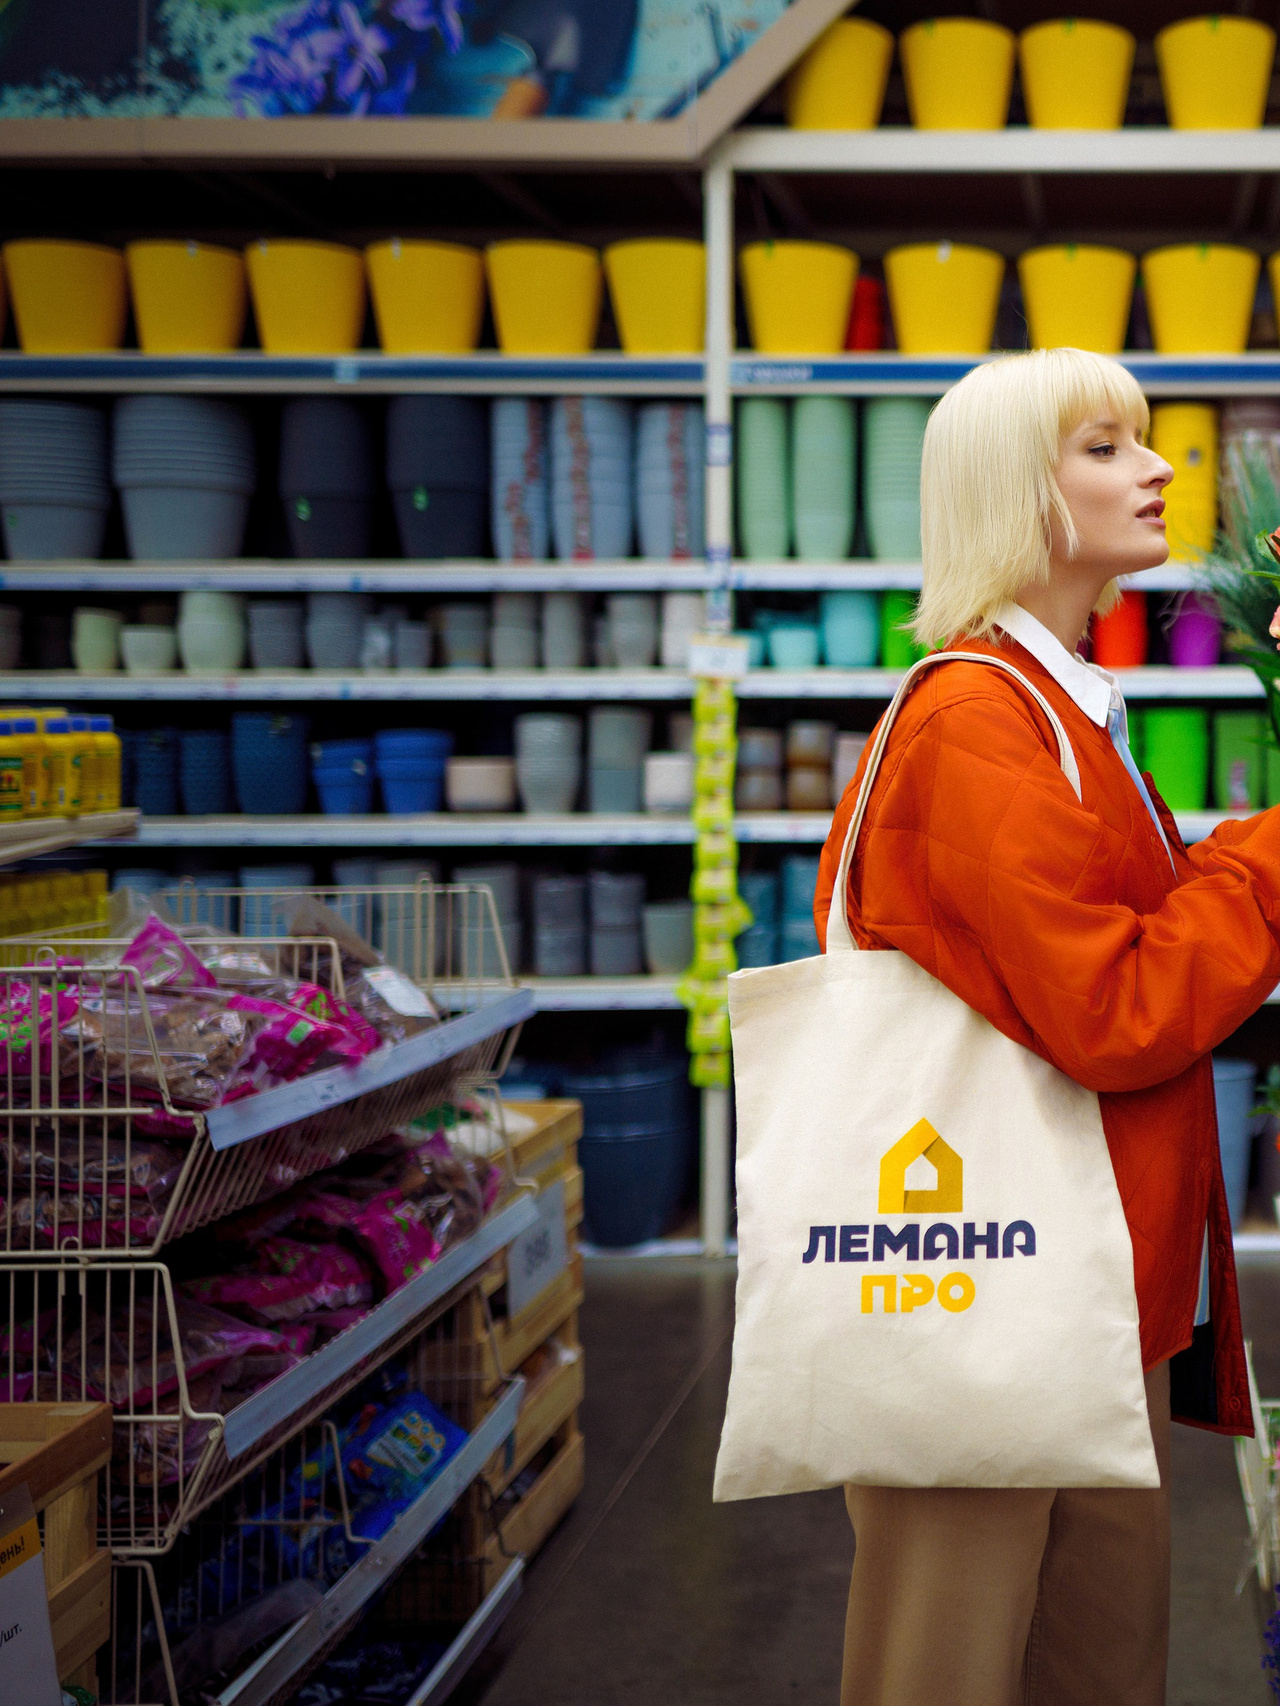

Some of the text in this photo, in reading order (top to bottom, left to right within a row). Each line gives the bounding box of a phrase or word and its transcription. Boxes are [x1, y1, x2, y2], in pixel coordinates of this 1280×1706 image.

[802, 1220, 1036, 1263] ЛЕМАНА
[861, 1272, 976, 1313] ПРО
[0, 1536, 25, 1570] ень!
